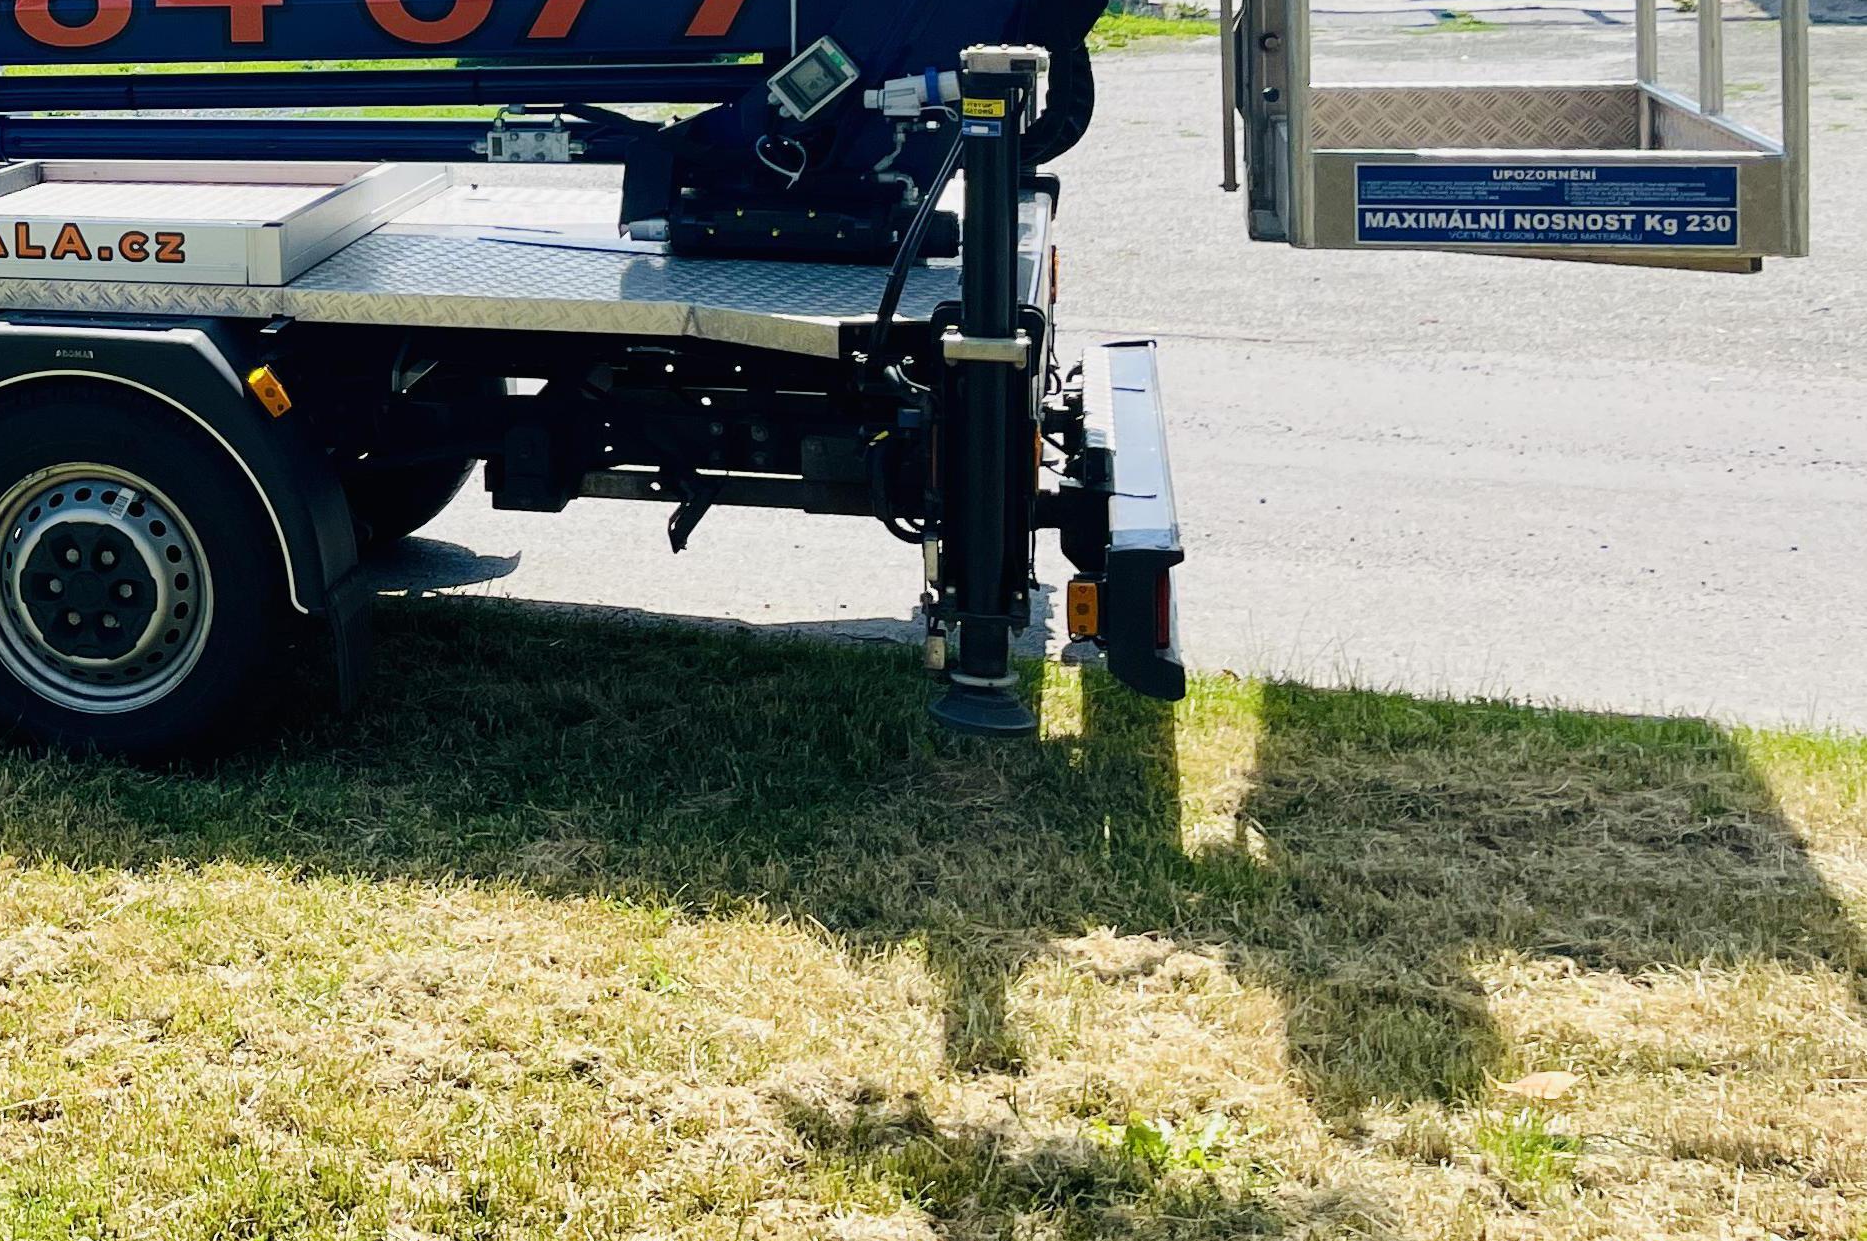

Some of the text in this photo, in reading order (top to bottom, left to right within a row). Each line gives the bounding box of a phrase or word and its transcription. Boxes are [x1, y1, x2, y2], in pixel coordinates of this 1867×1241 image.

[1365, 209, 1732, 236] MAXIMÁLNÍ NOSNOST Kg 230
